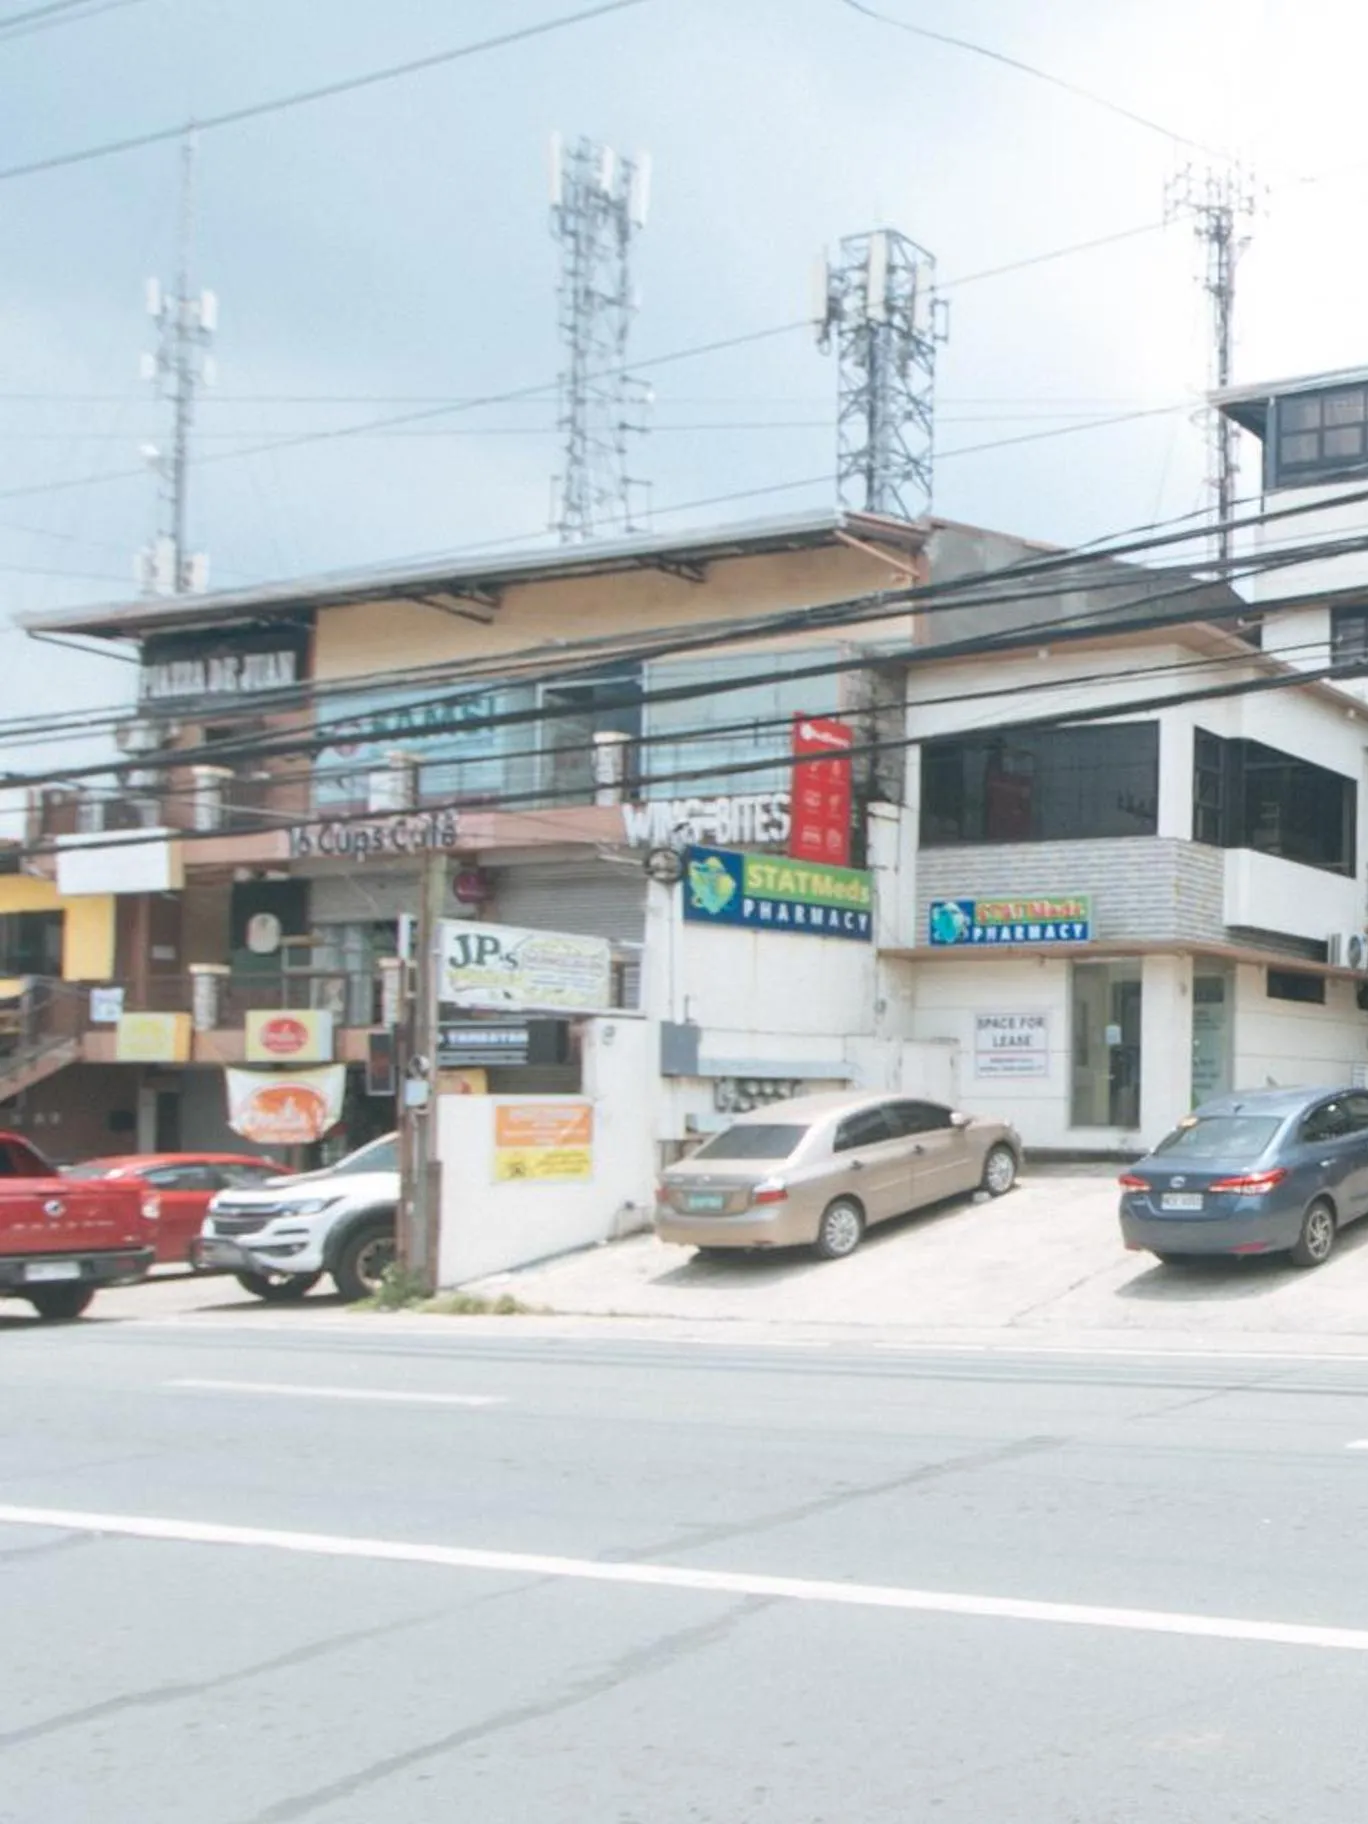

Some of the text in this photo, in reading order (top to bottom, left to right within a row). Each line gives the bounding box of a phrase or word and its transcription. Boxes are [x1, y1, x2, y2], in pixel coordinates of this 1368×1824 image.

[239, 651, 297, 690] JUAN
[319, 822, 385, 863] Cups
[747, 862, 871, 904] STATMeds
[742, 899, 869, 932] PHARMACY
[973, 923, 1085, 942] PHARMACY
[977, 1016, 1044, 1030] SPACE FOR
[992, 1034, 1033, 1047] LEASE
